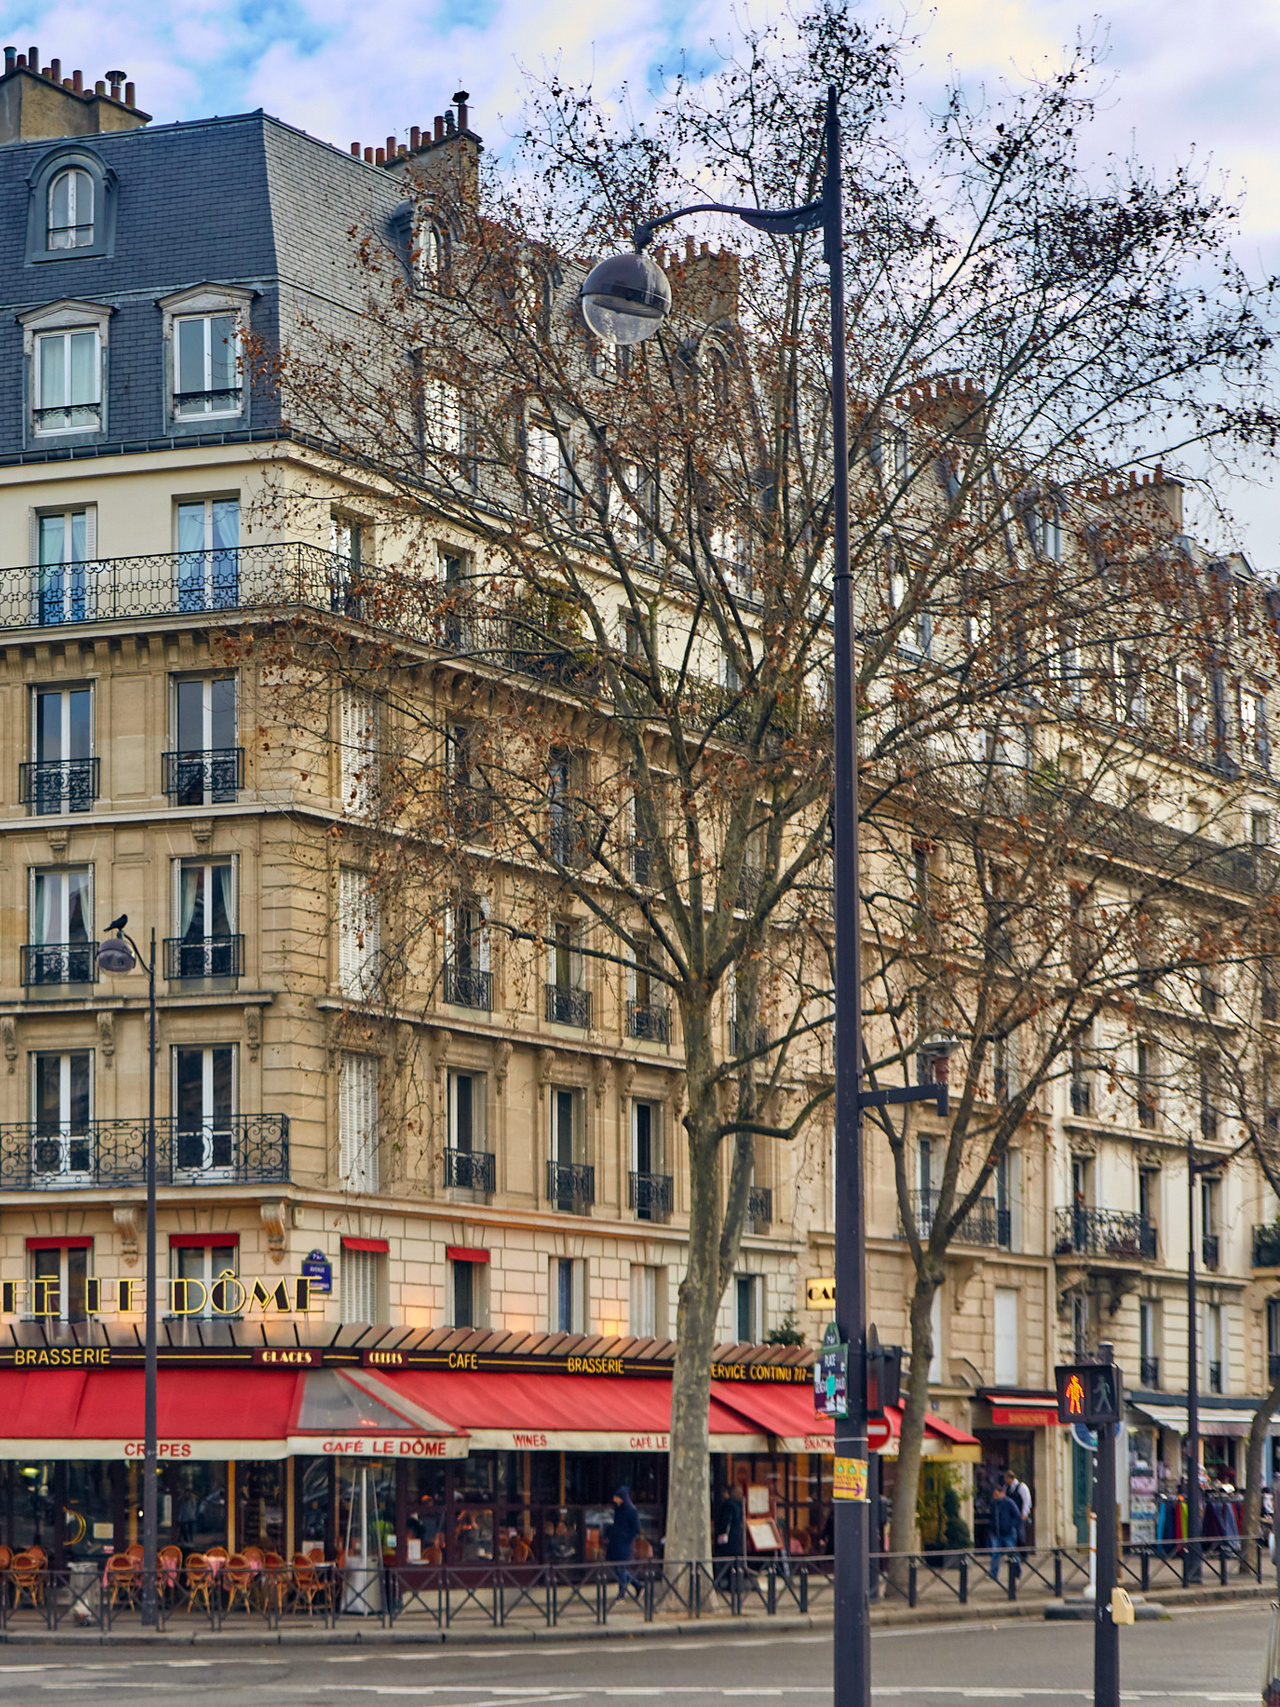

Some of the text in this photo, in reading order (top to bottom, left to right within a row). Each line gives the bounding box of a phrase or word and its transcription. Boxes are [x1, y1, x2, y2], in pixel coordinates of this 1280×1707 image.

[86, 1277, 147, 1314] LE
[172, 1269, 325, 1313] DÔME
[15, 1348, 111, 1365] BRASSERIE
[262, 1351, 313, 1364] GLACES
[448, 1352, 479, 1370] CAFE
[567, 1357, 625, 1374] BRASSERIE
[711, 1363, 747, 1379] ERVICE
[750, 1365, 791, 1380] CONTINU
[322, 1438, 447, 1456] CAFÉ LE DÔME
[513, 1433, 548, 1448] WINES
[630, 1434, 668, 1449] CAFÉ LE
[124, 1442, 192, 1457] CRPES
